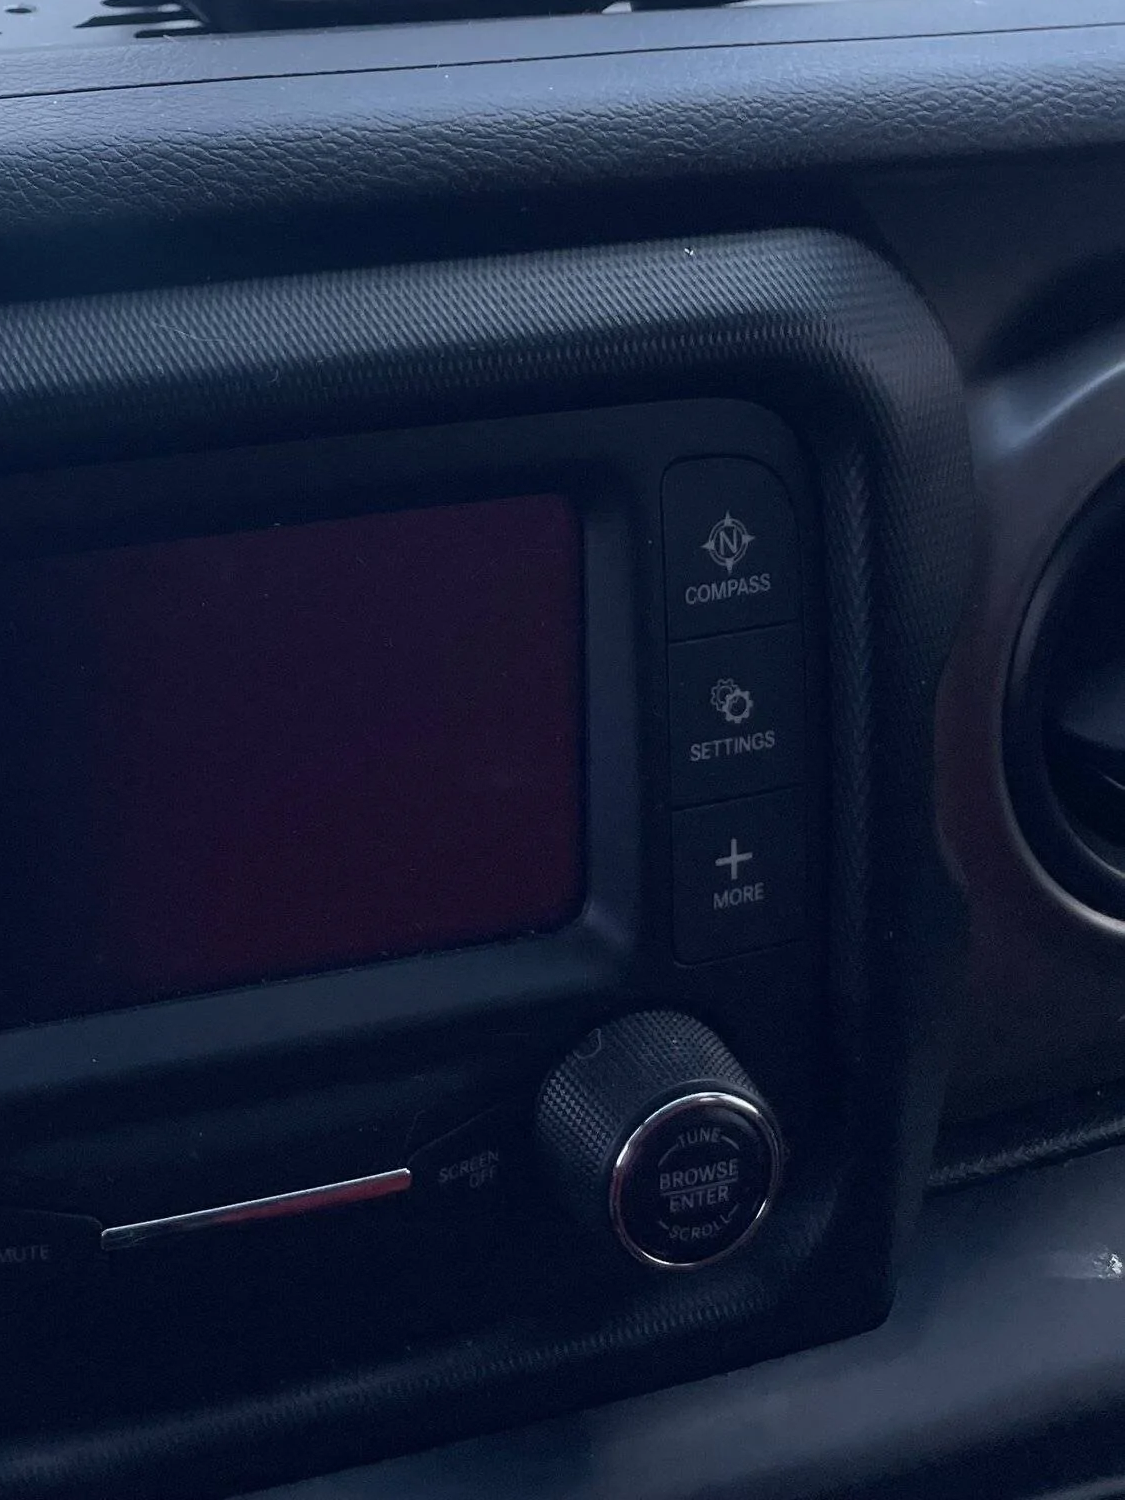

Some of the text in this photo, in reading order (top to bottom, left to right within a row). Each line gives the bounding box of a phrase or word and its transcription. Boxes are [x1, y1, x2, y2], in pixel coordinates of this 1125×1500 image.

[685, 573, 771, 605] COMPASS
[689, 730, 775, 762] SETTINGS
[712, 882, 765, 910] MORE
[678, 1126, 721, 1149] TUNE
[438, 1150, 499, 1183] SCREEN
[469, 1165, 497, 1189] OFF
[659, 1158, 739, 1191] BROWSE
[668, 1185, 730, 1213] ENTER
[669, 1213, 730, 1242] SCROLL
